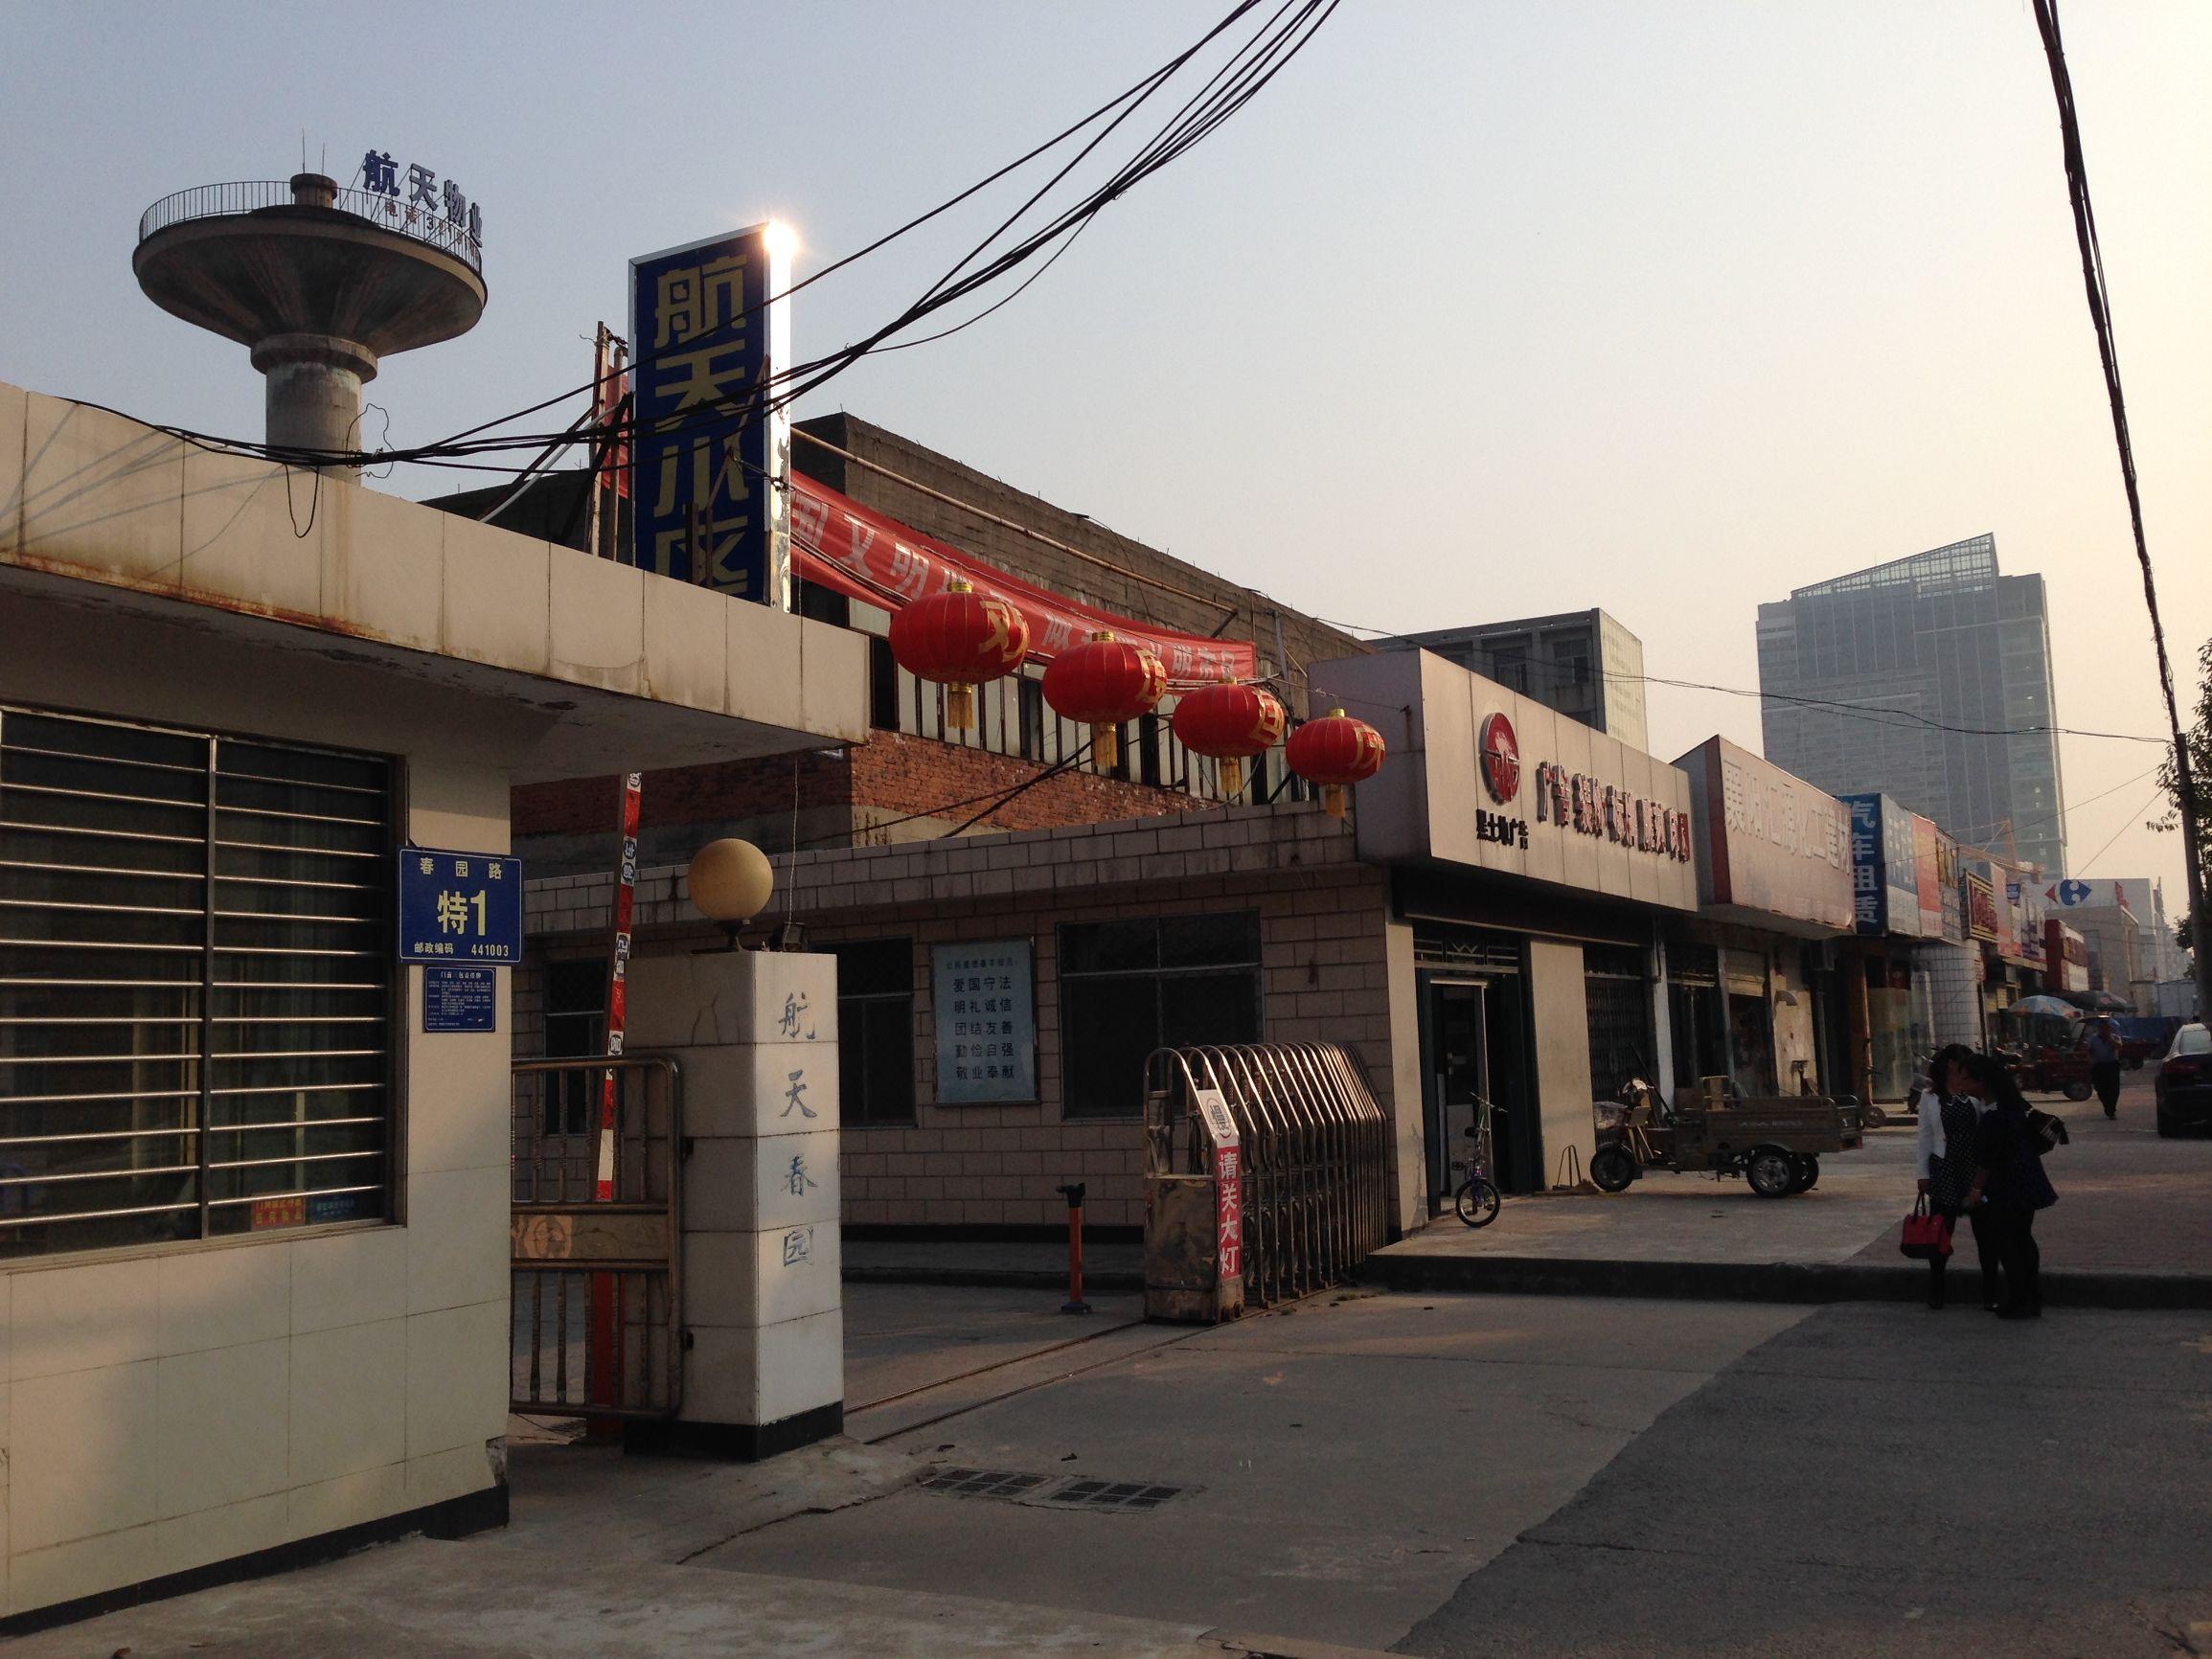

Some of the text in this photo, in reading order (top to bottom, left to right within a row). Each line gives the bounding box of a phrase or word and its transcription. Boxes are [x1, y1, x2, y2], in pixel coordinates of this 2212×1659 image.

[362, 149, 483, 248] 航天物业
[420, 856, 503, 880] 春园路
[437, 890, 487, 936] 特1
[414, 942, 509, 957] 邮政编码 441003
[953, 977, 1012, 992] 爱国守法
[954, 998, 1013, 1014] 明礼诚信
[955, 1021, 1013, 1035] 团结友善
[955, 1042, 1015, 1058] 勤俭自强
[956, 1064, 1015, 1080] 敬业奉献
[778, 991, 818, 1266] 航天春园
[1219, 1150, 1239, 1275] 请关大灯
